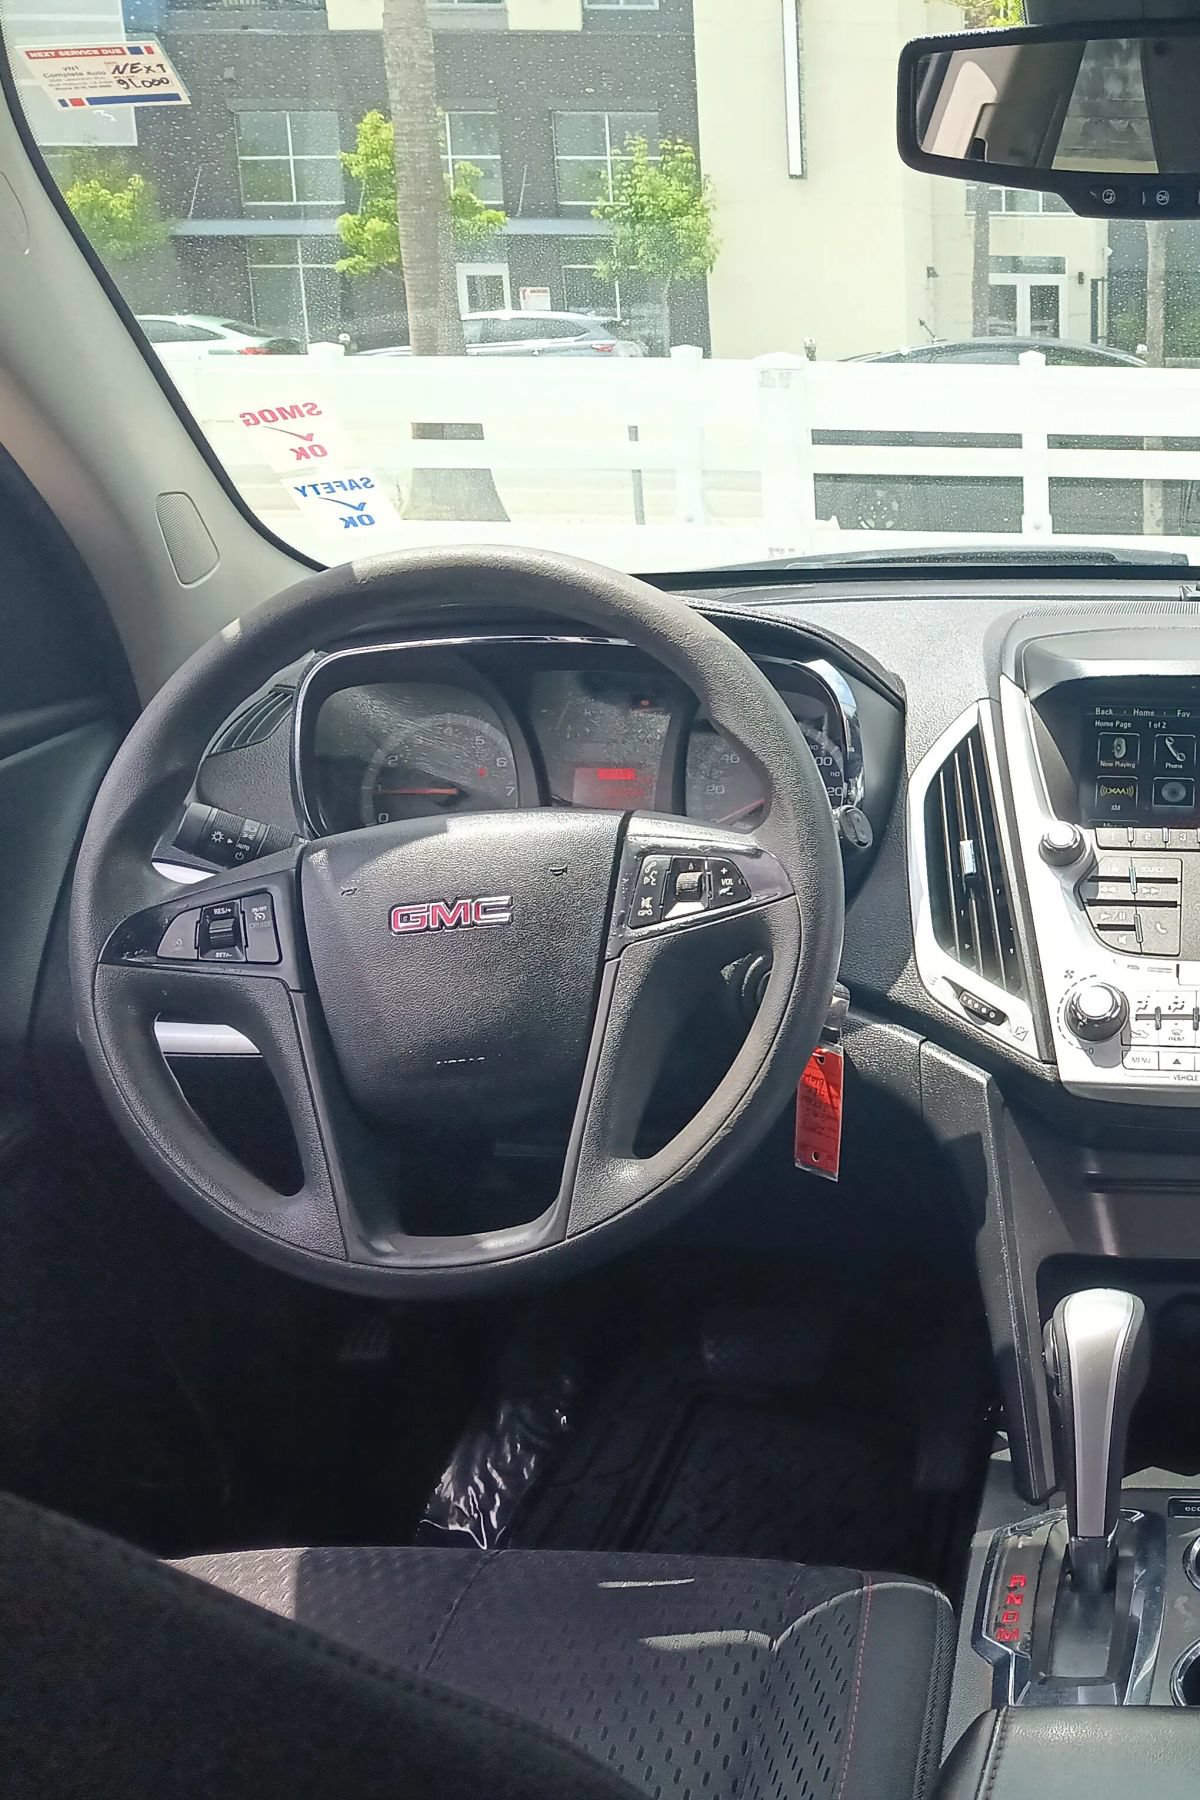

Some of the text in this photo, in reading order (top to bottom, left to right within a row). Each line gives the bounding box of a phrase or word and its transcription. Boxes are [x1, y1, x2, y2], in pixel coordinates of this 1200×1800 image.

[58, 49, 100, 57] SERVICE
[102, 48, 123, 56] DUE
[43, 71, 84, 79] Complete
[1095, 707, 1191, 718] Back Home Fav
[1095, 720, 1114, 728] Home
[1115, 720, 1132, 729] Page
[1153, 721, 1161, 729] of
[1162, 721, 1167, 729] 2
[475, 736, 486, 746] 5
[387, 755, 399, 766] 2
[496, 757, 508, 768] 6
[720, 753, 741, 764] 40
[815, 756, 833, 767] 00
[1114, 761, 1136, 769] Playing
[505, 786, 516, 797] 7
[705, 784, 725, 796] 20
[826, 787, 844, 797] 20
[378, 812, 390, 824] 0
[721, 878, 734, 886] VOL
[390, 895, 513, 934] GMC
[1006, 1592, 1025, 1606] N
[996, 1627, 1019, 1642] M
